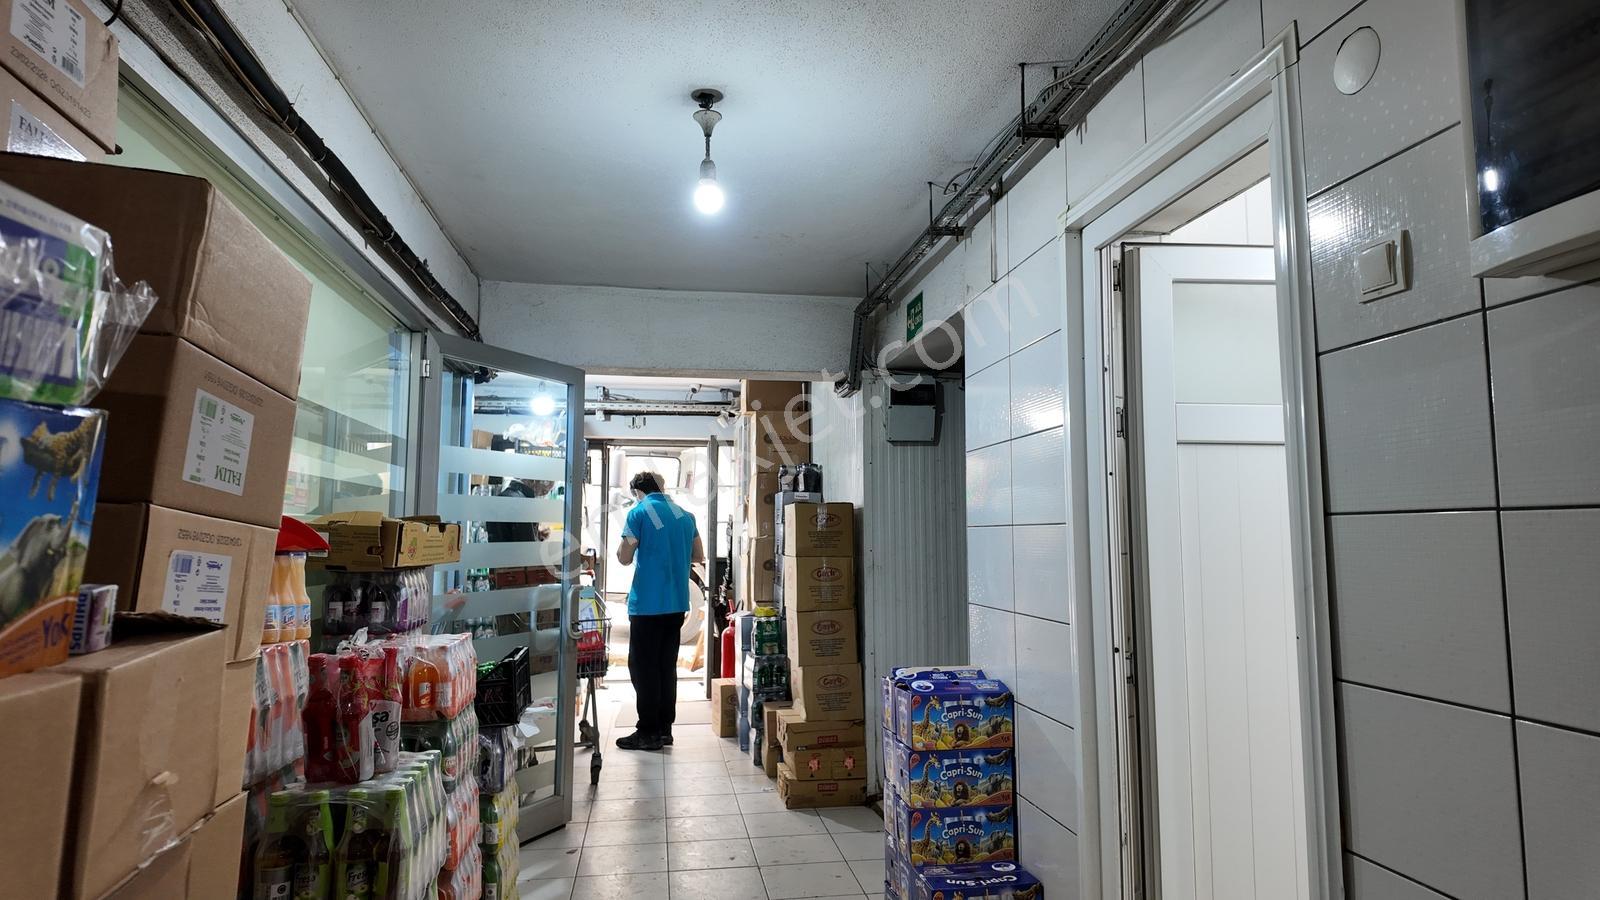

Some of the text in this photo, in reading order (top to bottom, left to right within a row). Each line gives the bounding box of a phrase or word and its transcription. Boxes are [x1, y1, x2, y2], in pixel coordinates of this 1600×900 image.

[214, 464, 243, 487] FALIM
[70, 592, 88, 650] PHILIPS
[940, 708, 984, 723] Capri-Sun
[940, 765, 984, 781] Capri-Sun
[941, 823, 985, 840] Capri-Sun
[946, 875, 1018, 887] Capri-Sun
